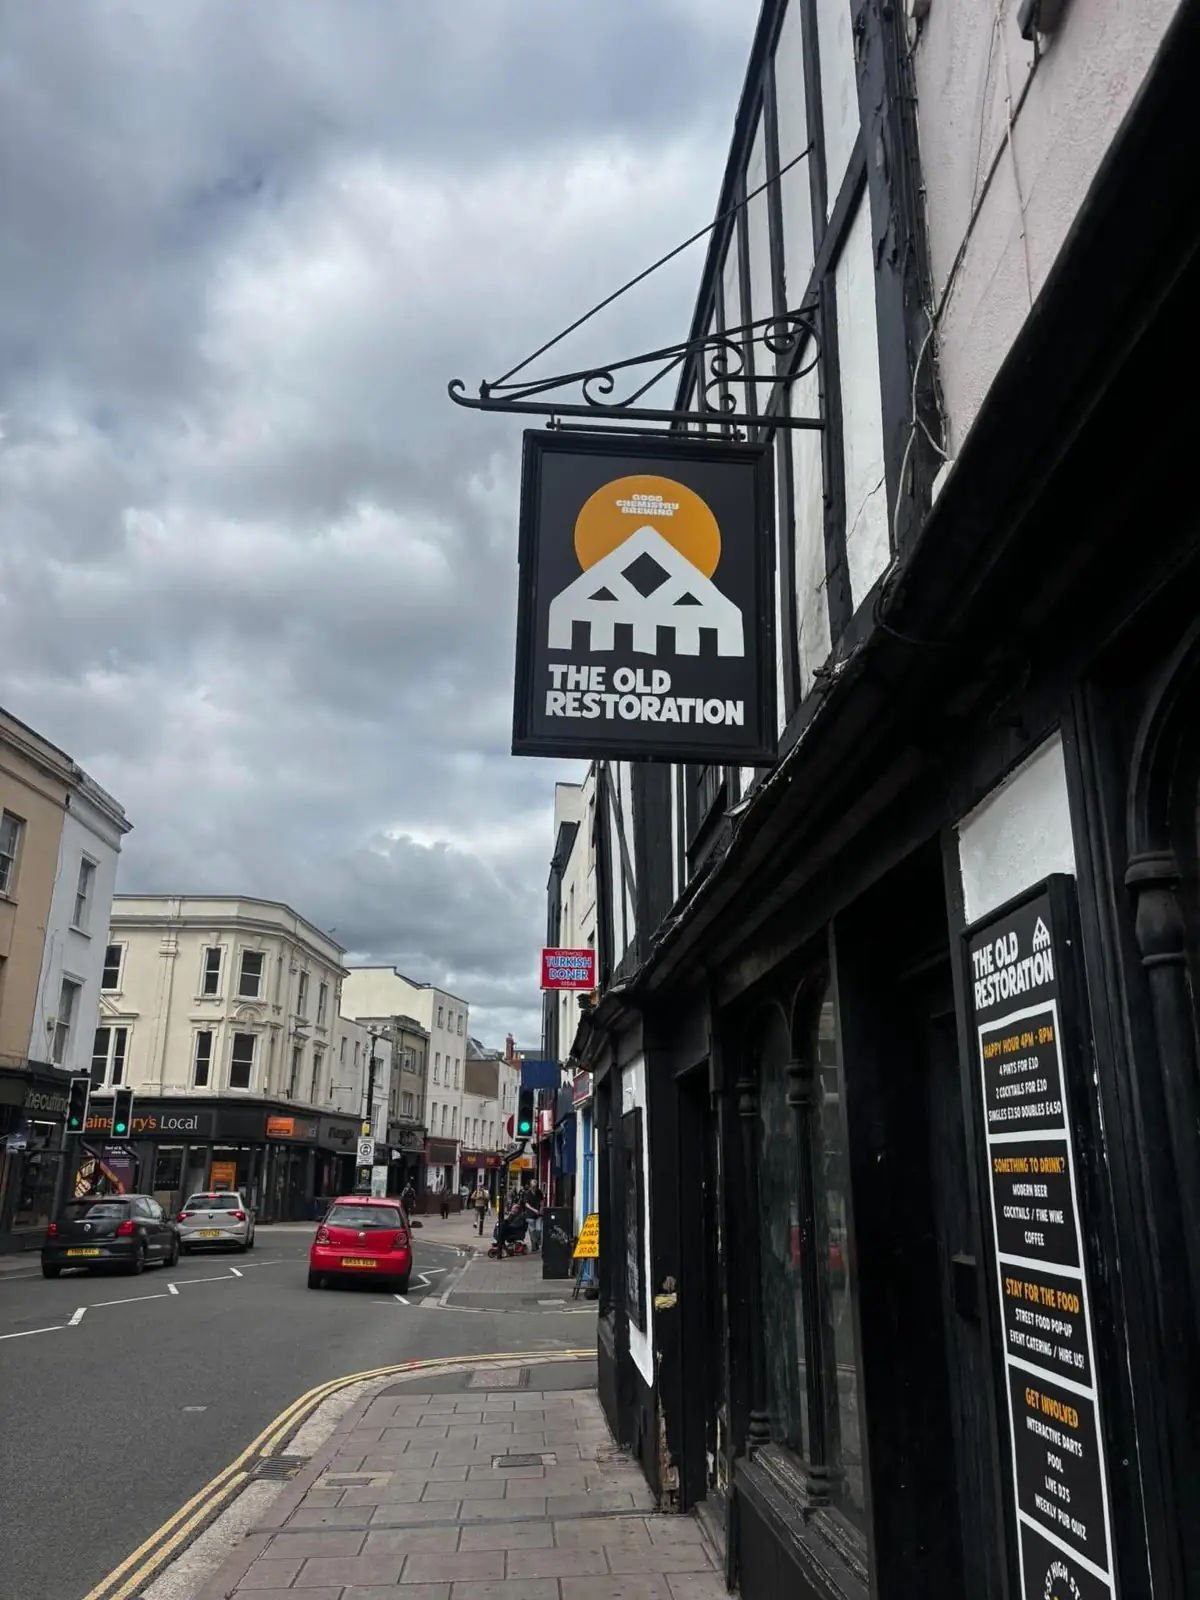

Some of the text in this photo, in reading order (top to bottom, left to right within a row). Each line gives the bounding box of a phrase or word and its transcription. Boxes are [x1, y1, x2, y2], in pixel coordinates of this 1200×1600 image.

[616, 500, 679, 510] CHEMISTRY
[622, 507, 673, 516] BREWING
[548, 664, 671, 694] THE OLD
[545, 690, 744, 726] RESTORATION
[545, 956, 592, 968] TURKISH
[972, 931, 1018, 979] THE OLD
[549, 968, 589, 980] DONER
[974, 947, 1054, 1011] RESTORATION
[984, 1041, 1001, 1059] HAPPY
[1003, 1036, 1020, 1053] HOUR
[1021, 1031, 1034, 1048] 4PM
[1038, 1026, 1054, 1044] 8PM
[999, 1065, 1003, 1076] 4
[1003, 1061, 1017, 1075] PINTS
[1018, 1059, 1028, 1072] FOR
[996, 1087, 1000, 1099] 2
[1000, 1082, 1025, 1098] COCKTAILS
[1025, 1080, 1036, 1094] FOR
[989, 1107, 1007, 1121] SINGLES
[1021, 1103, 1045, 1117] DOUBLES
[85, 1114, 198, 1132] ainsry's Local
[994, 1157, 1065, 1174] SOMETHING TO DRINK?
[1012, 1184, 1048, 1197] MODERN BEER
[1004, 1206, 1030, 1220] COCKTAILS
[1036, 1208, 1049, 1222] FINE
[1049, 1209, 1064, 1224] WINE
[1025, 1231, 1045, 1246] COFFEE
[1006, 1278, 1080, 1314] STAY FOR THE FOOD
[1015, 1308, 1073, 1338] STREET FOOD POP-UP
[1009, 1329, 1025, 1346] EVENT
[1026, 1335, 1052, 1356] CATERING
[1058, 1347, 1073, 1364] HIRE
[1073, 1352, 1085, 1369] US!
[1025, 1387, 1079, 1428] GET INVOLVED
[1026, 1416, 1083, 1457] INTERACTIVE DARTS
[1047, 1451, 1064, 1473] POOL
[1044, 1475, 1057, 1495] LIVE
[1034, 1493, 1087, 1540] WEEKLY PUB QUIZ
[1050, 1561, 1068, 1583] HIGH
